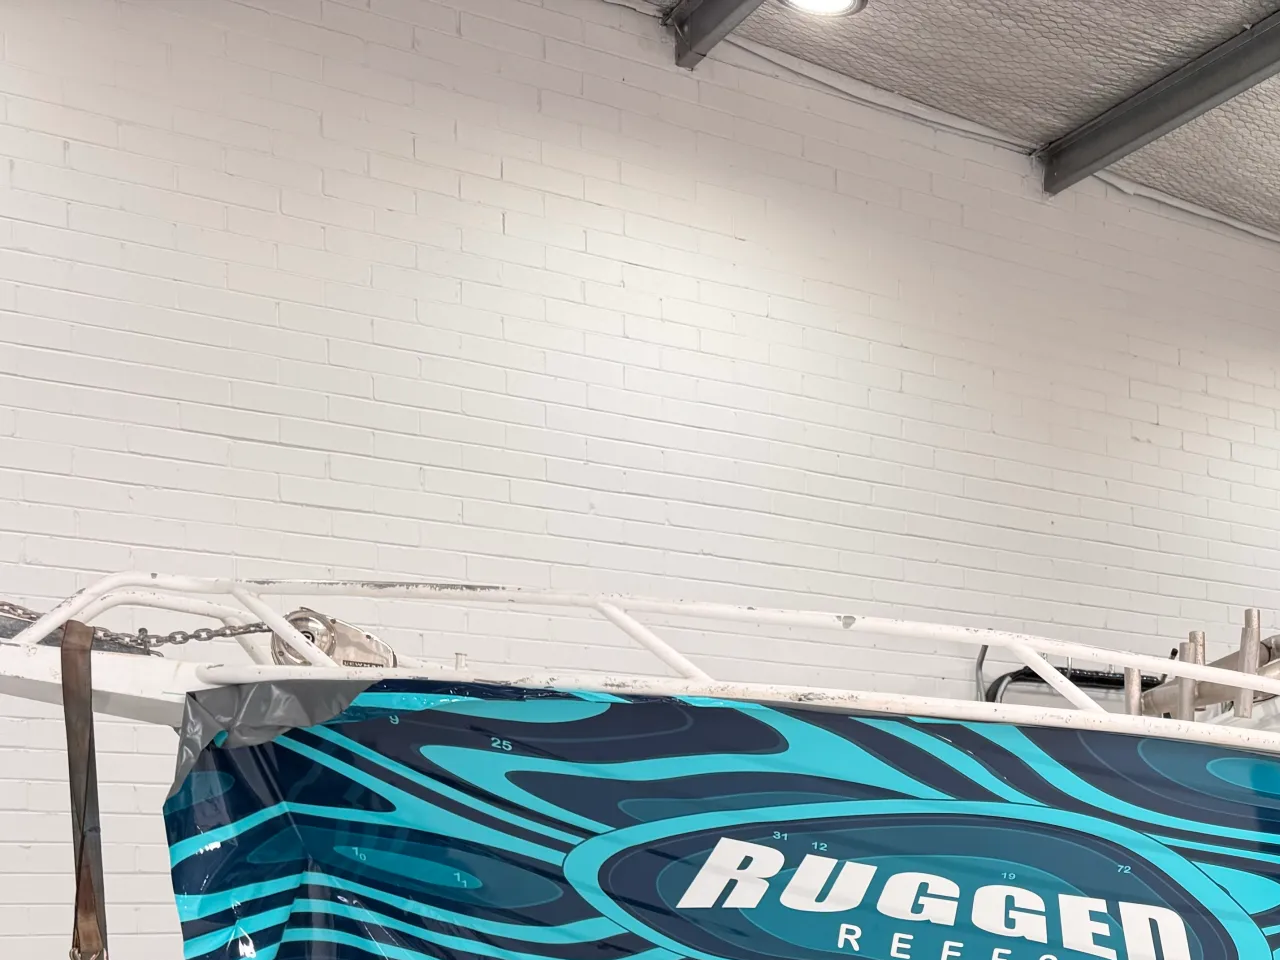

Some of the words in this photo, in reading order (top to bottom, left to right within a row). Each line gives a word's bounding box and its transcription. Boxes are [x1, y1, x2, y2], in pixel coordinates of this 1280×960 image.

[491, 736, 513, 751] 25
[772, 831, 788, 841] 31
[811, 841, 828, 851] 12
[1117, 865, 1132, 874] 72
[1001, 872, 1016, 880] 19
